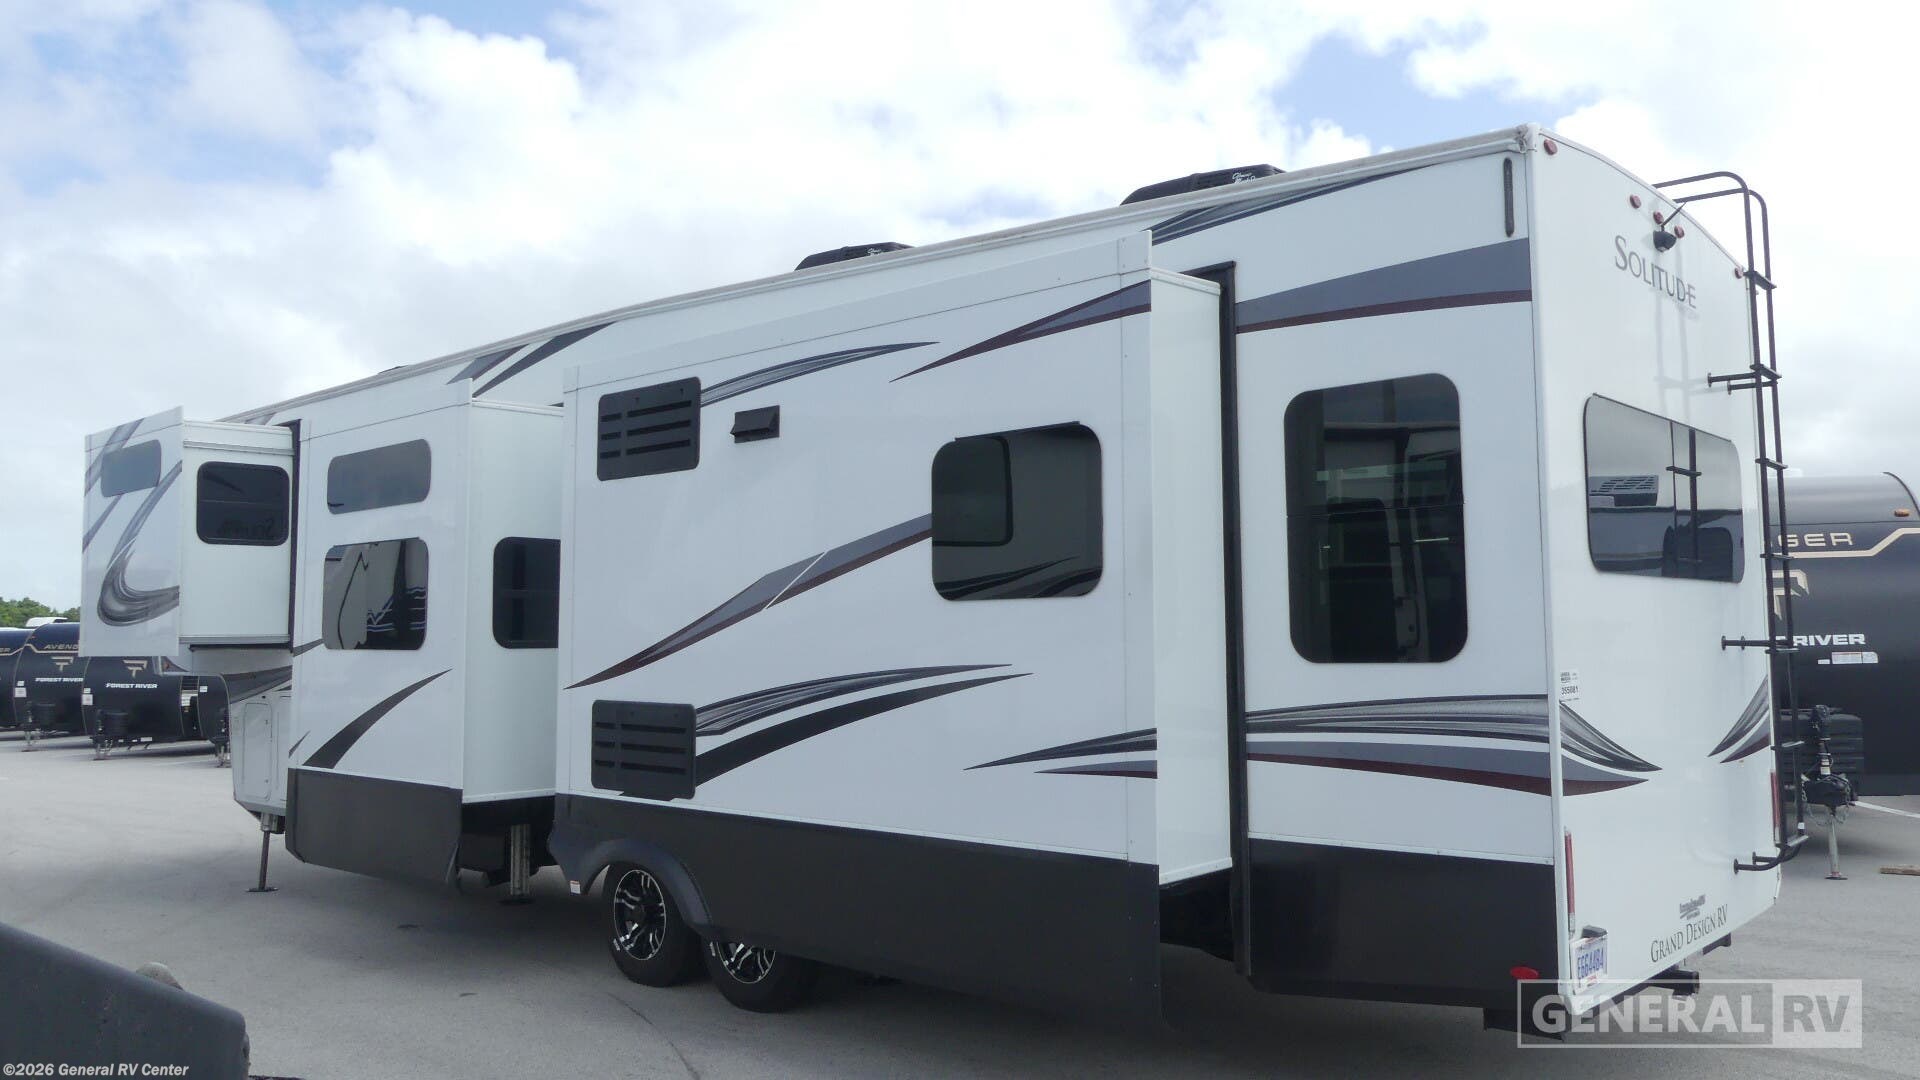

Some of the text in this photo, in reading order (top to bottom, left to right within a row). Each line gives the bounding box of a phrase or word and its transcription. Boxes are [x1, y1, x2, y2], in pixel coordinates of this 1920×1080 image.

[1614, 234, 1697, 310] SOLITUDE
[1792, 633, 1866, 647] RIVER
[1650, 931, 1684, 963] GRAND
[1686, 912, 1716, 945] DESIGN
[1717, 903, 1728, 928] RV
